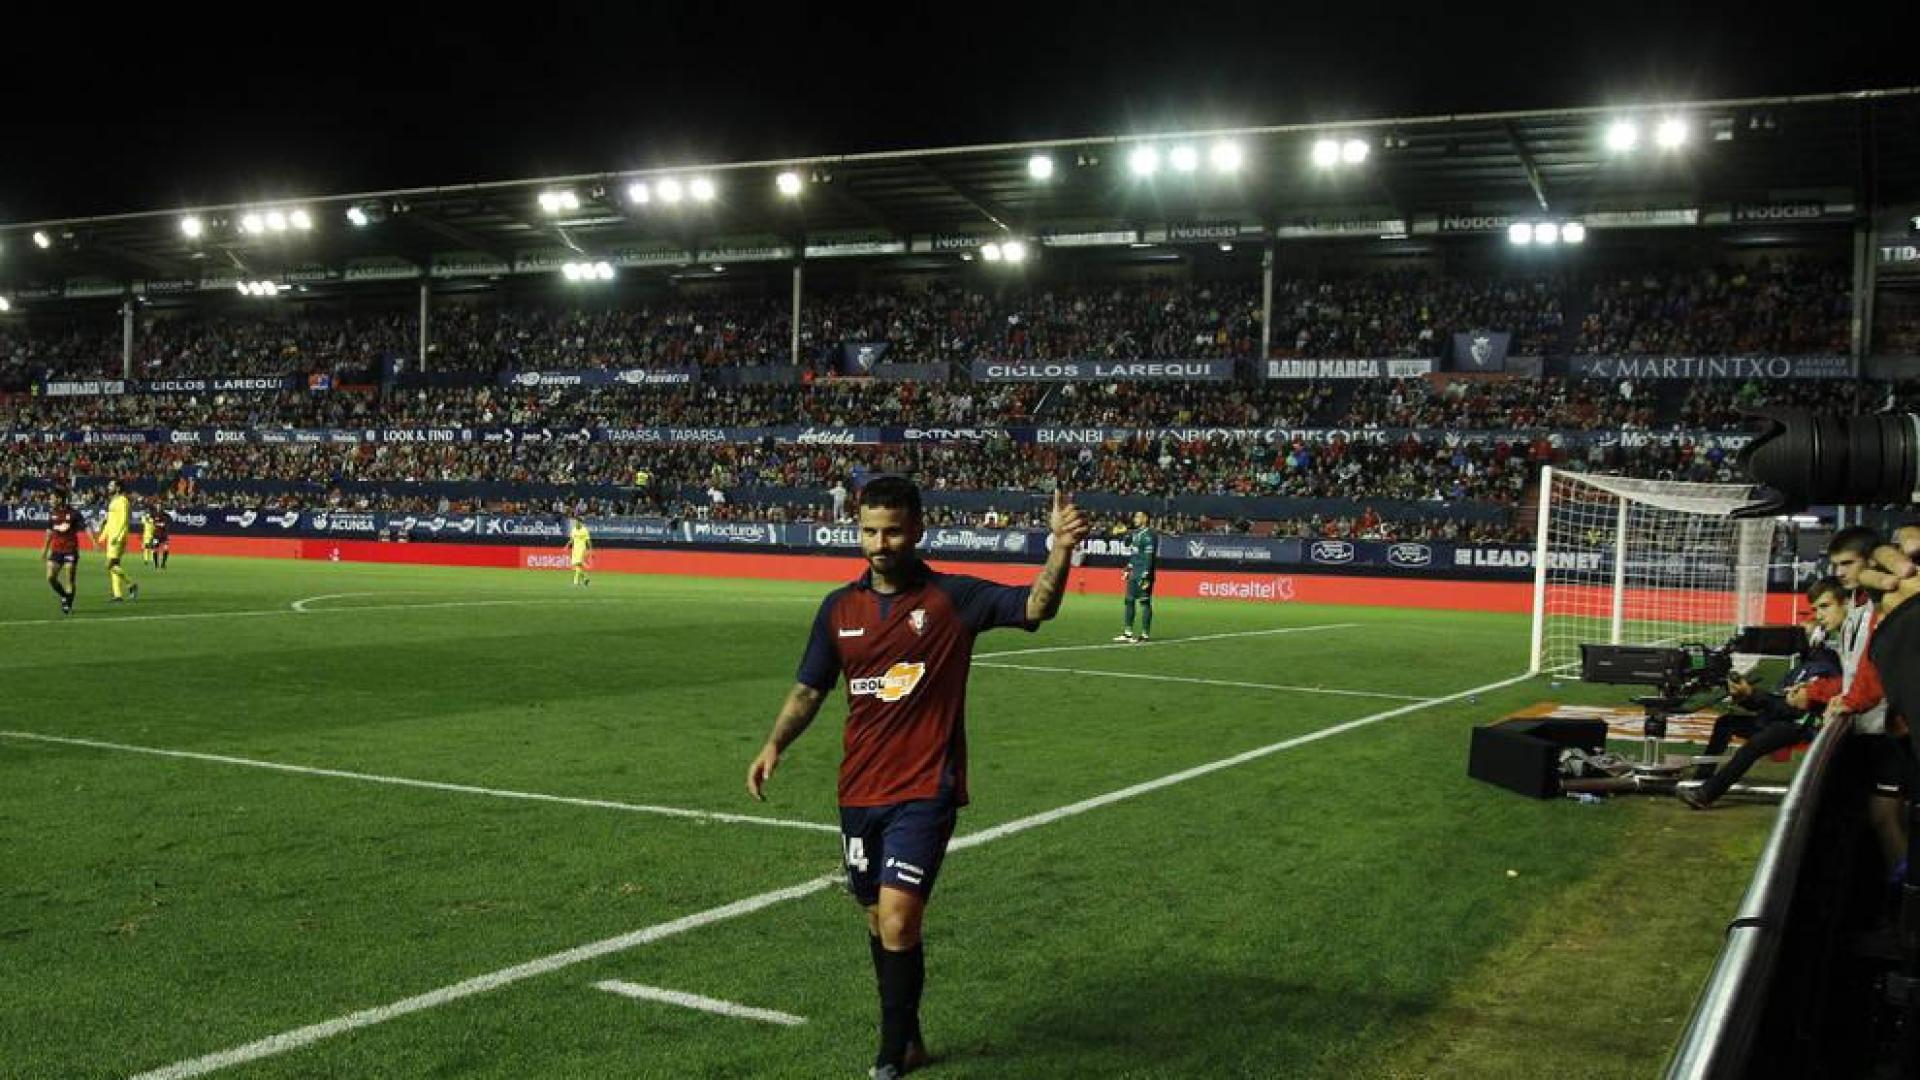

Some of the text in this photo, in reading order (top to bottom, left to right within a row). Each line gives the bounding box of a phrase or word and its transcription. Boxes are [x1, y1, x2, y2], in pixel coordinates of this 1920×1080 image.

[987, 363, 1211, 378] CICLOS LAREQUI
[1268, 360, 1315, 378] RADIO
[1319, 360, 1379, 377] MARCA
[1616, 357, 1792, 378] MARTINTXO
[383, 430, 454, 441] LOOK & FIND
[607, 429, 726, 441] TAPARSA TAPARSA
[1037, 430, 1104, 443] BIANBI
[331, 521, 375, 531] ACUNSA
[503, 519, 562, 533] CaixaBank
[831, 527, 862, 542] SEL
[528, 554, 572, 567] euskalt
[1199, 577, 1275, 599] euskaltel
